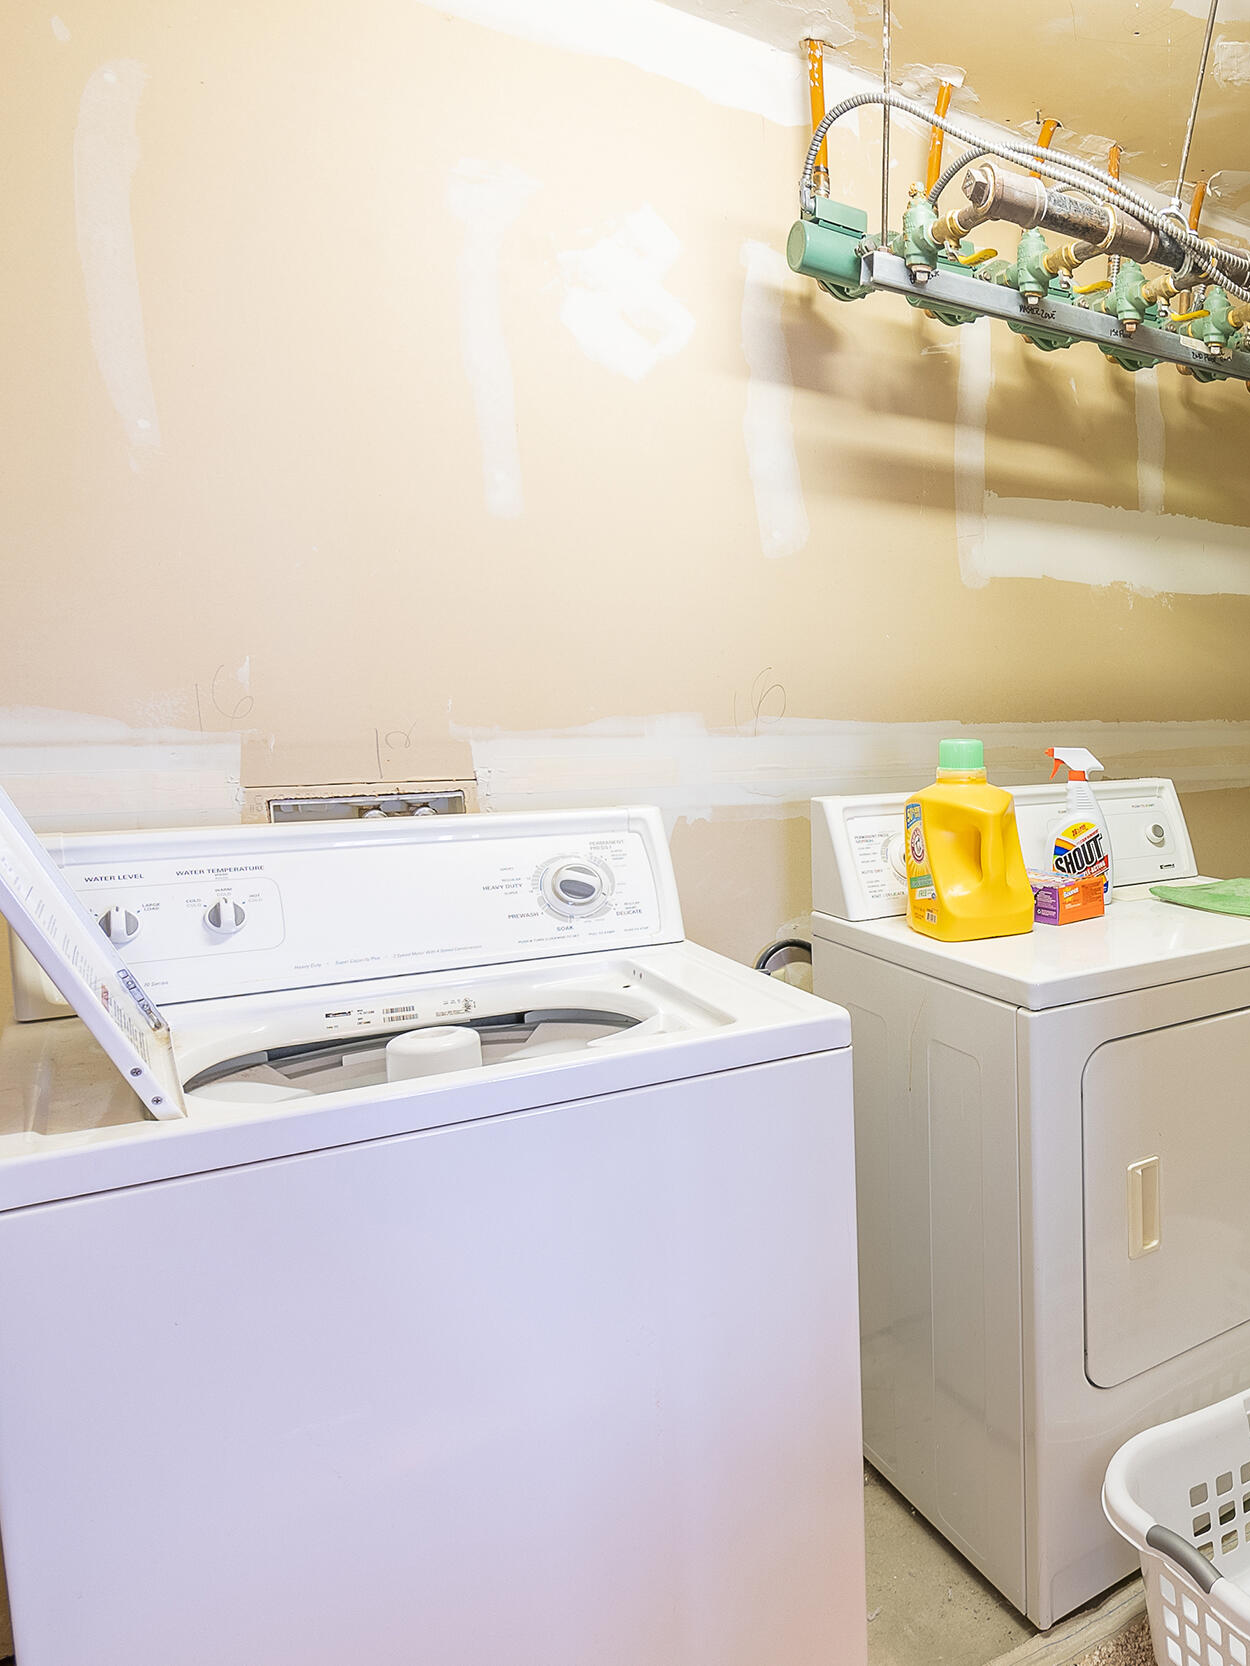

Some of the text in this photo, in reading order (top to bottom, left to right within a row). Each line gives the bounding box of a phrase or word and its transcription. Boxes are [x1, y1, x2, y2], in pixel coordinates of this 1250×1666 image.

[1054, 833, 1104, 874] SHOUT
[175, 868, 206, 877] WATER
[206, 864, 265, 875] TEMPERATURE
[84, 873, 145, 883] WATER LEVEL
[482, 882, 523, 891] HEAVY DUTY
[507, 911, 540, 920] PREWASH
[615, 908, 643, 917] DELICATE
